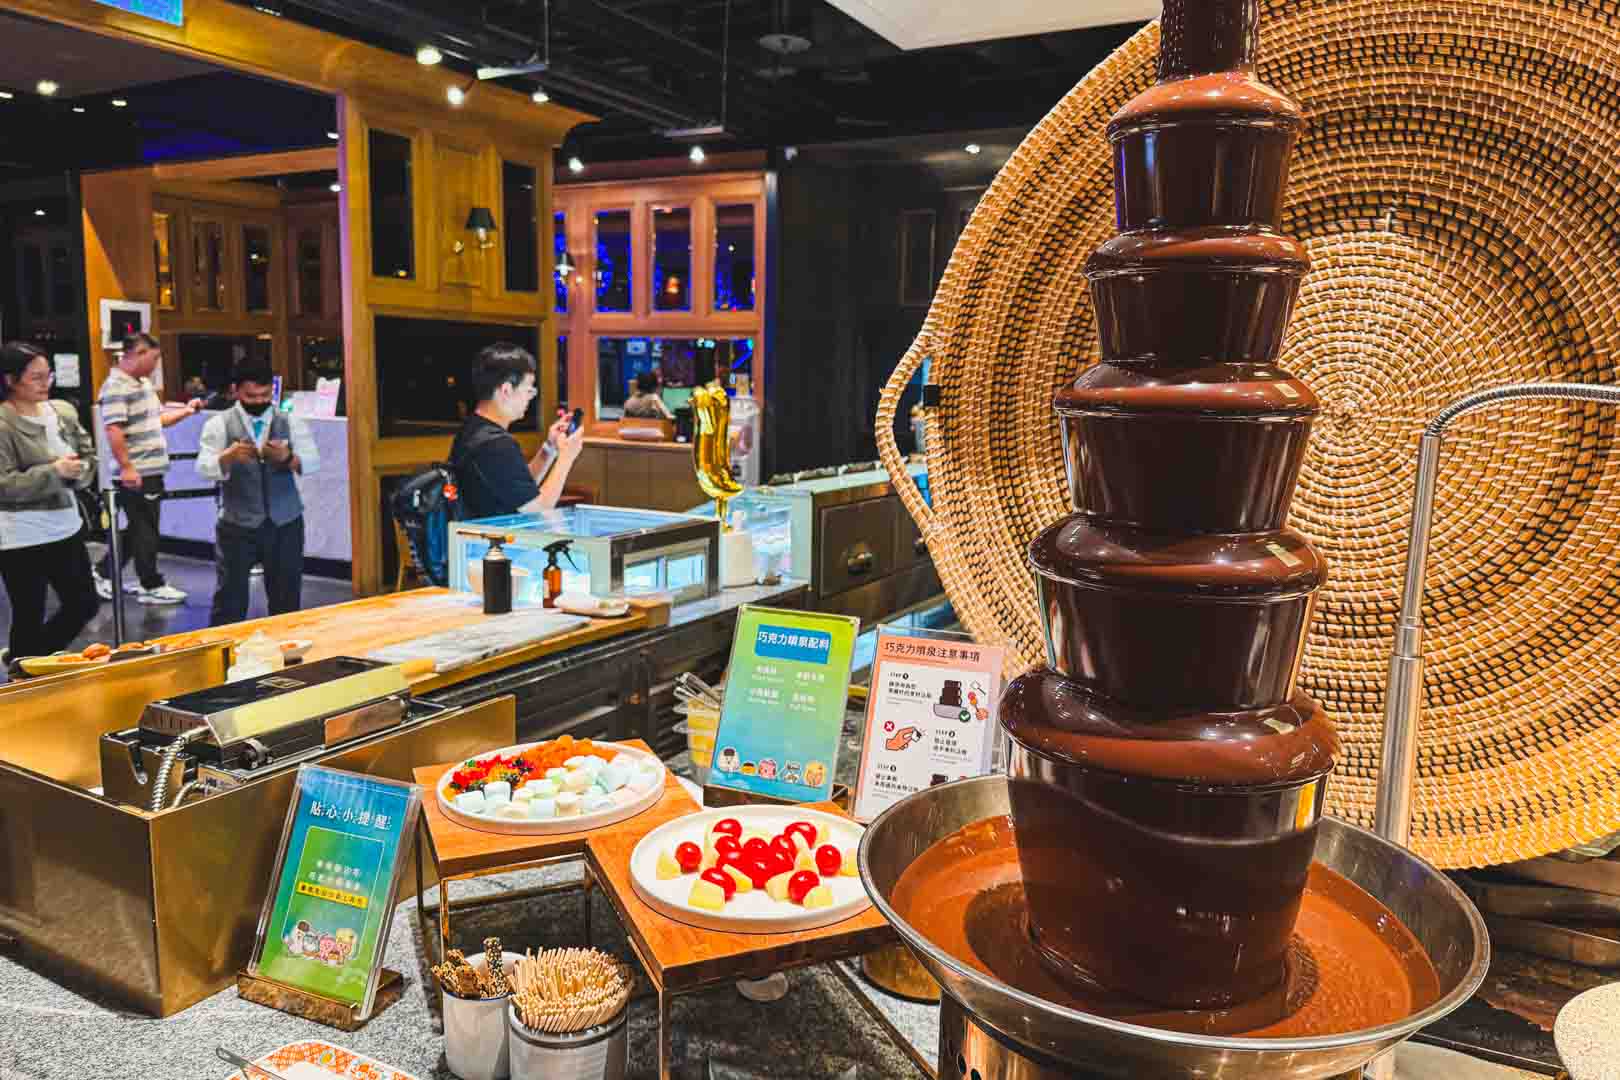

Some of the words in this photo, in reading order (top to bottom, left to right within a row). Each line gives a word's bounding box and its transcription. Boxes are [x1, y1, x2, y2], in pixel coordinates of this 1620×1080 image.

[885, 642, 980, 662] 巧克力噴泉注意事項
[311, 800, 390, 830] 貼心小提醒
